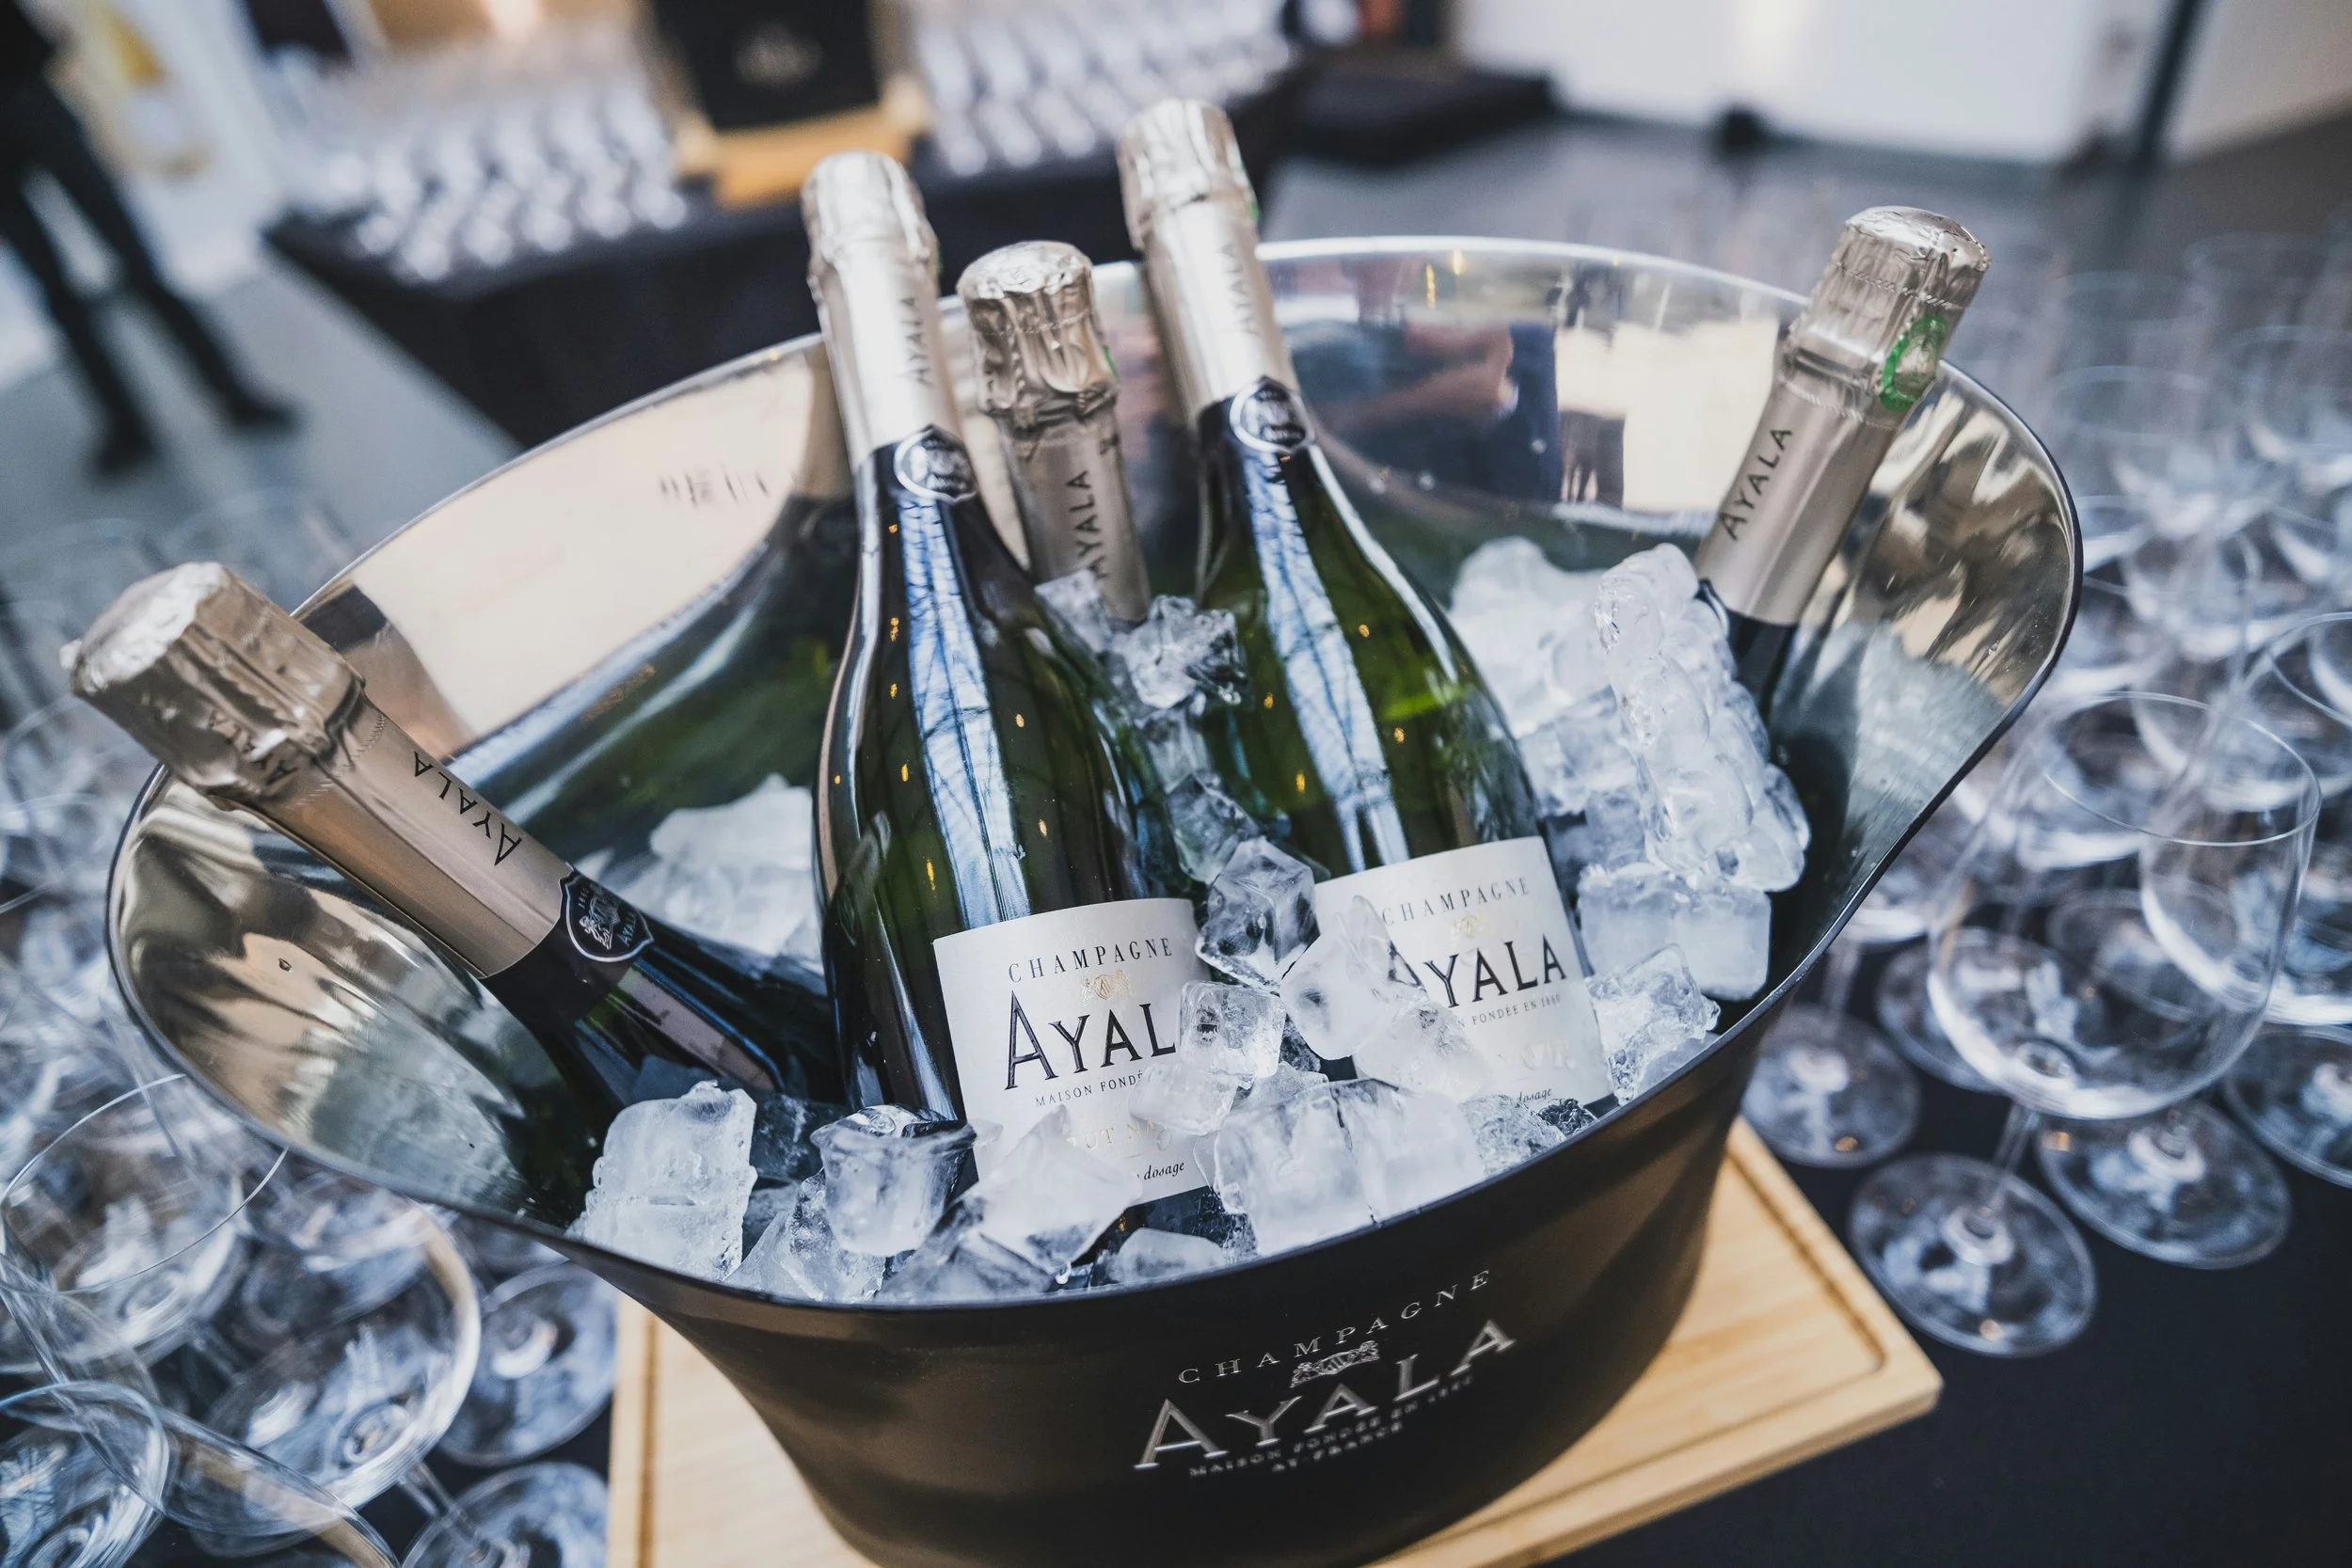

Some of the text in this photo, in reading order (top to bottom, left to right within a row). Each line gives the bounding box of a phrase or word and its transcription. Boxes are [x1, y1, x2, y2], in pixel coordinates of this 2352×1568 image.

[1718, 426, 1792, 541] AYALA
[414, 751, 523, 866] AYALA
[1381, 877, 1530, 927] CHAMPAGNE
[1008, 938, 1172, 983] CHAMPAGNE
[1004, 990, 1177, 1090] AYAL
[1471, 1003, 1519, 1025] FONDÉE
[1524, 1001, 1537, 1012] EN
[1035, 1085, 1093, 1108] MAISON
[1143, 1161, 1185, 1181] dosage
[1178, 1270, 1489, 1384] CHAMPAGNE
[1133, 1319, 1517, 1469] AYALA
